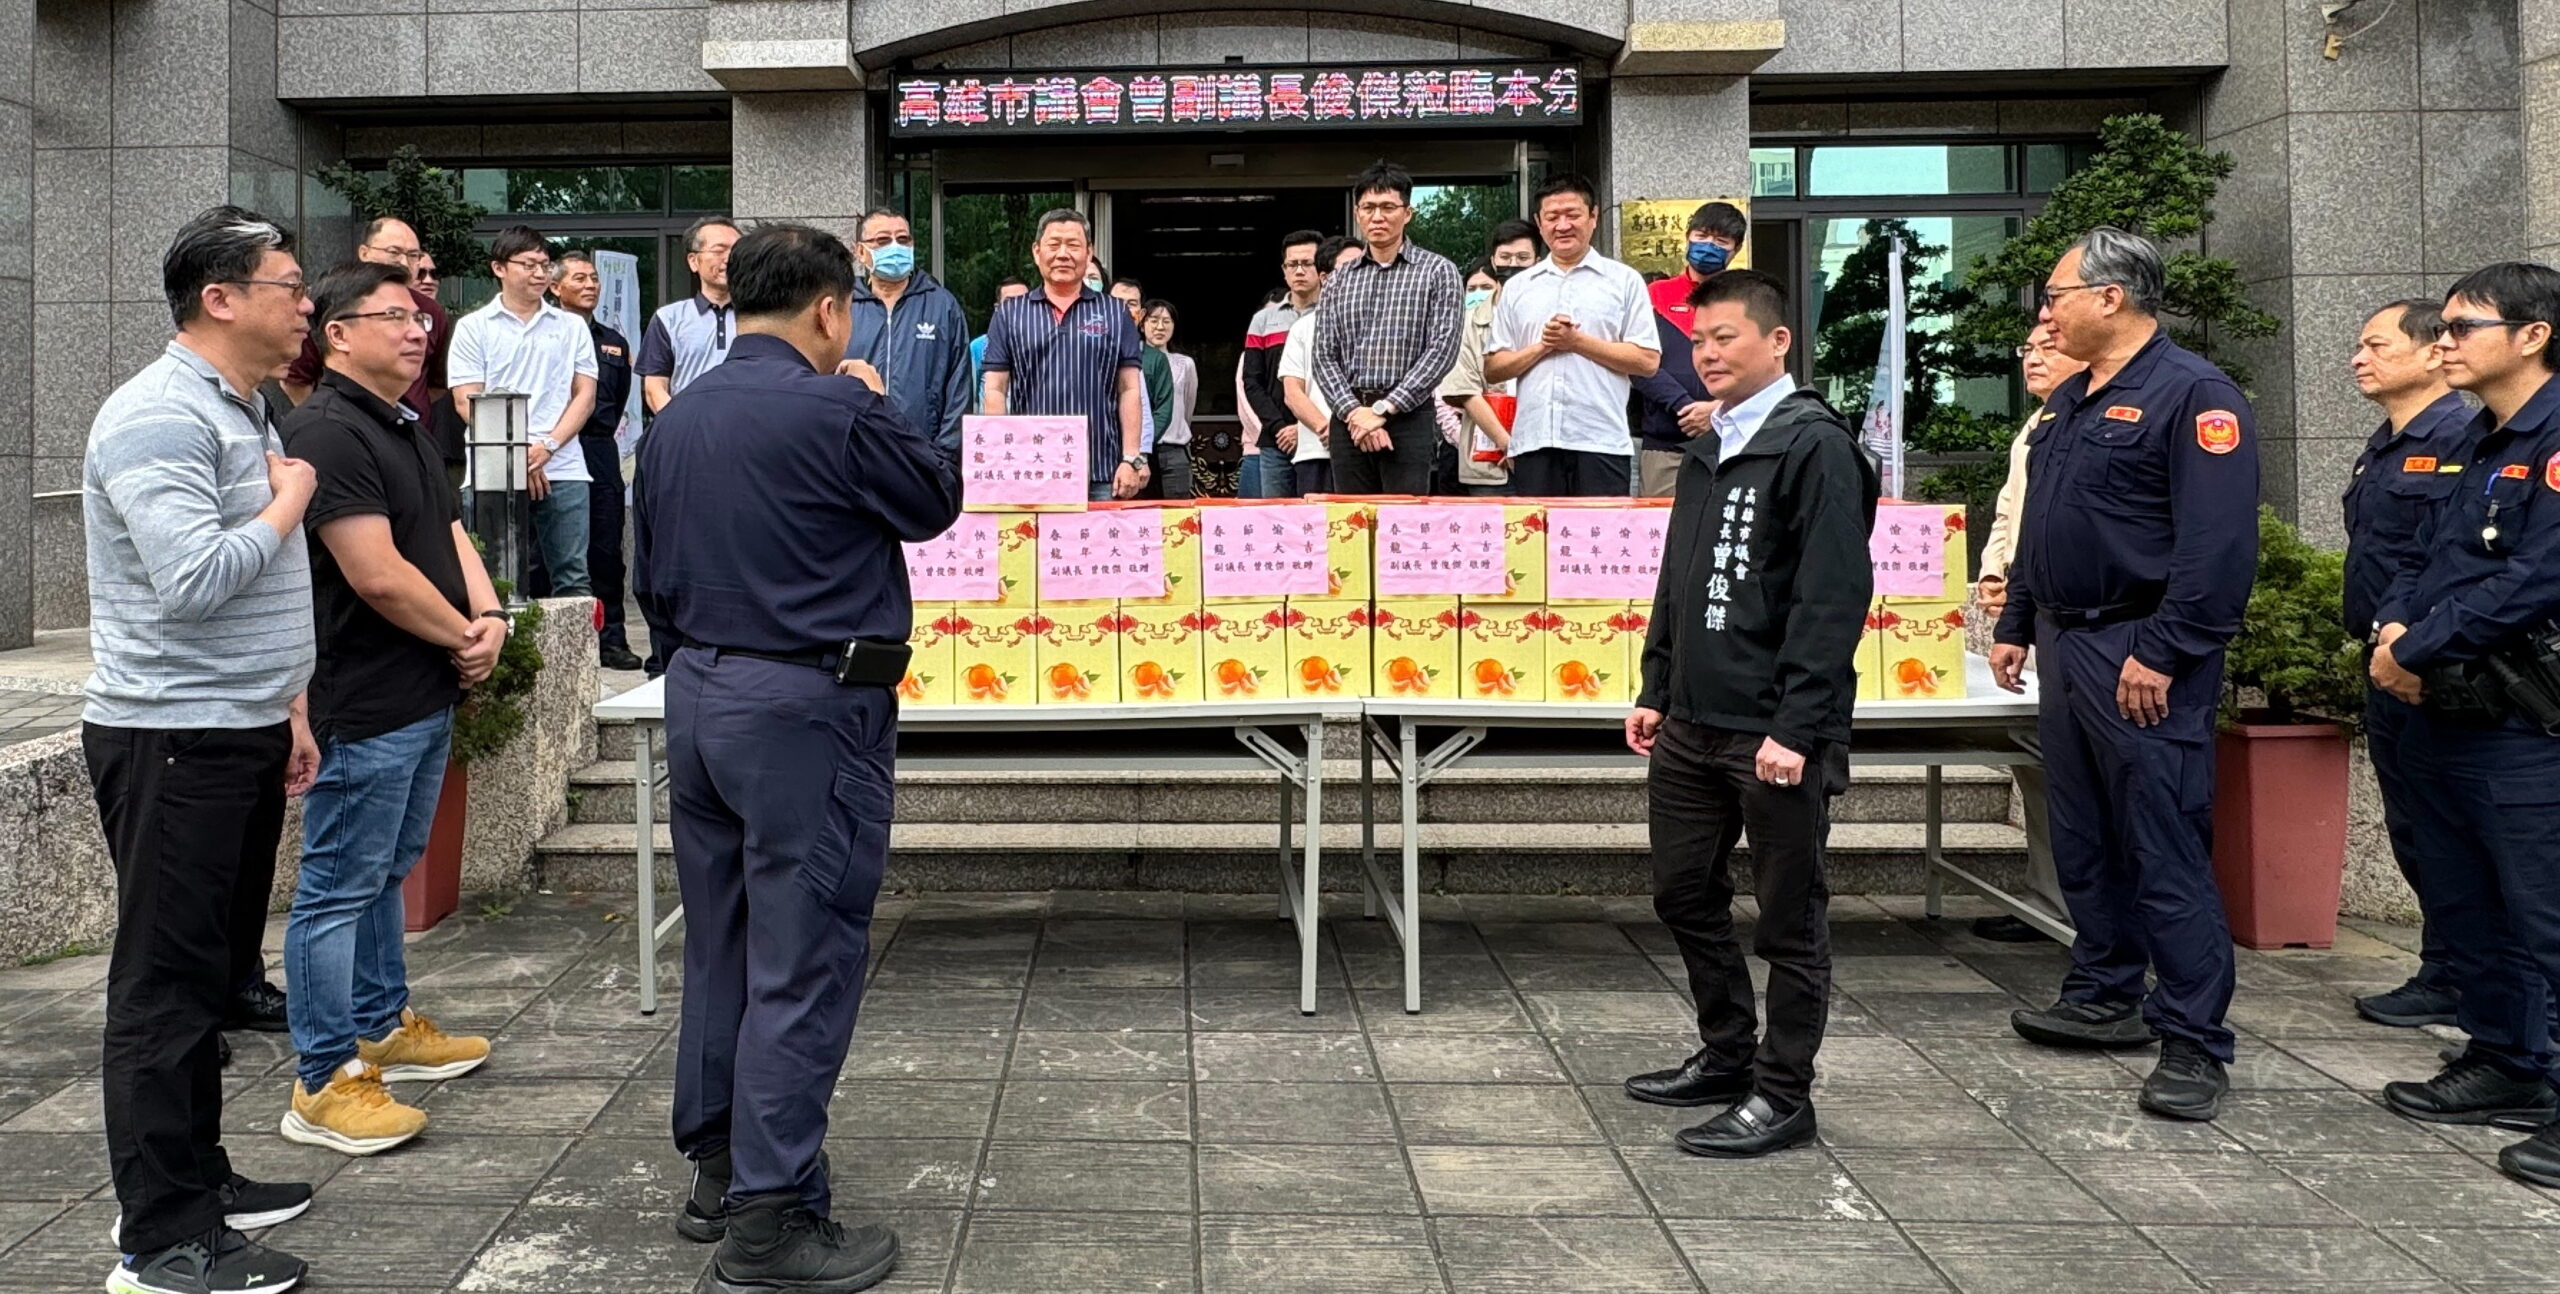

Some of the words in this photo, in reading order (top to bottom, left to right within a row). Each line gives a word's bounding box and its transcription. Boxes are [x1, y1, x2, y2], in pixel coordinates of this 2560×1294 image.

[1733, 487, 1757, 580] 高雄市議會
